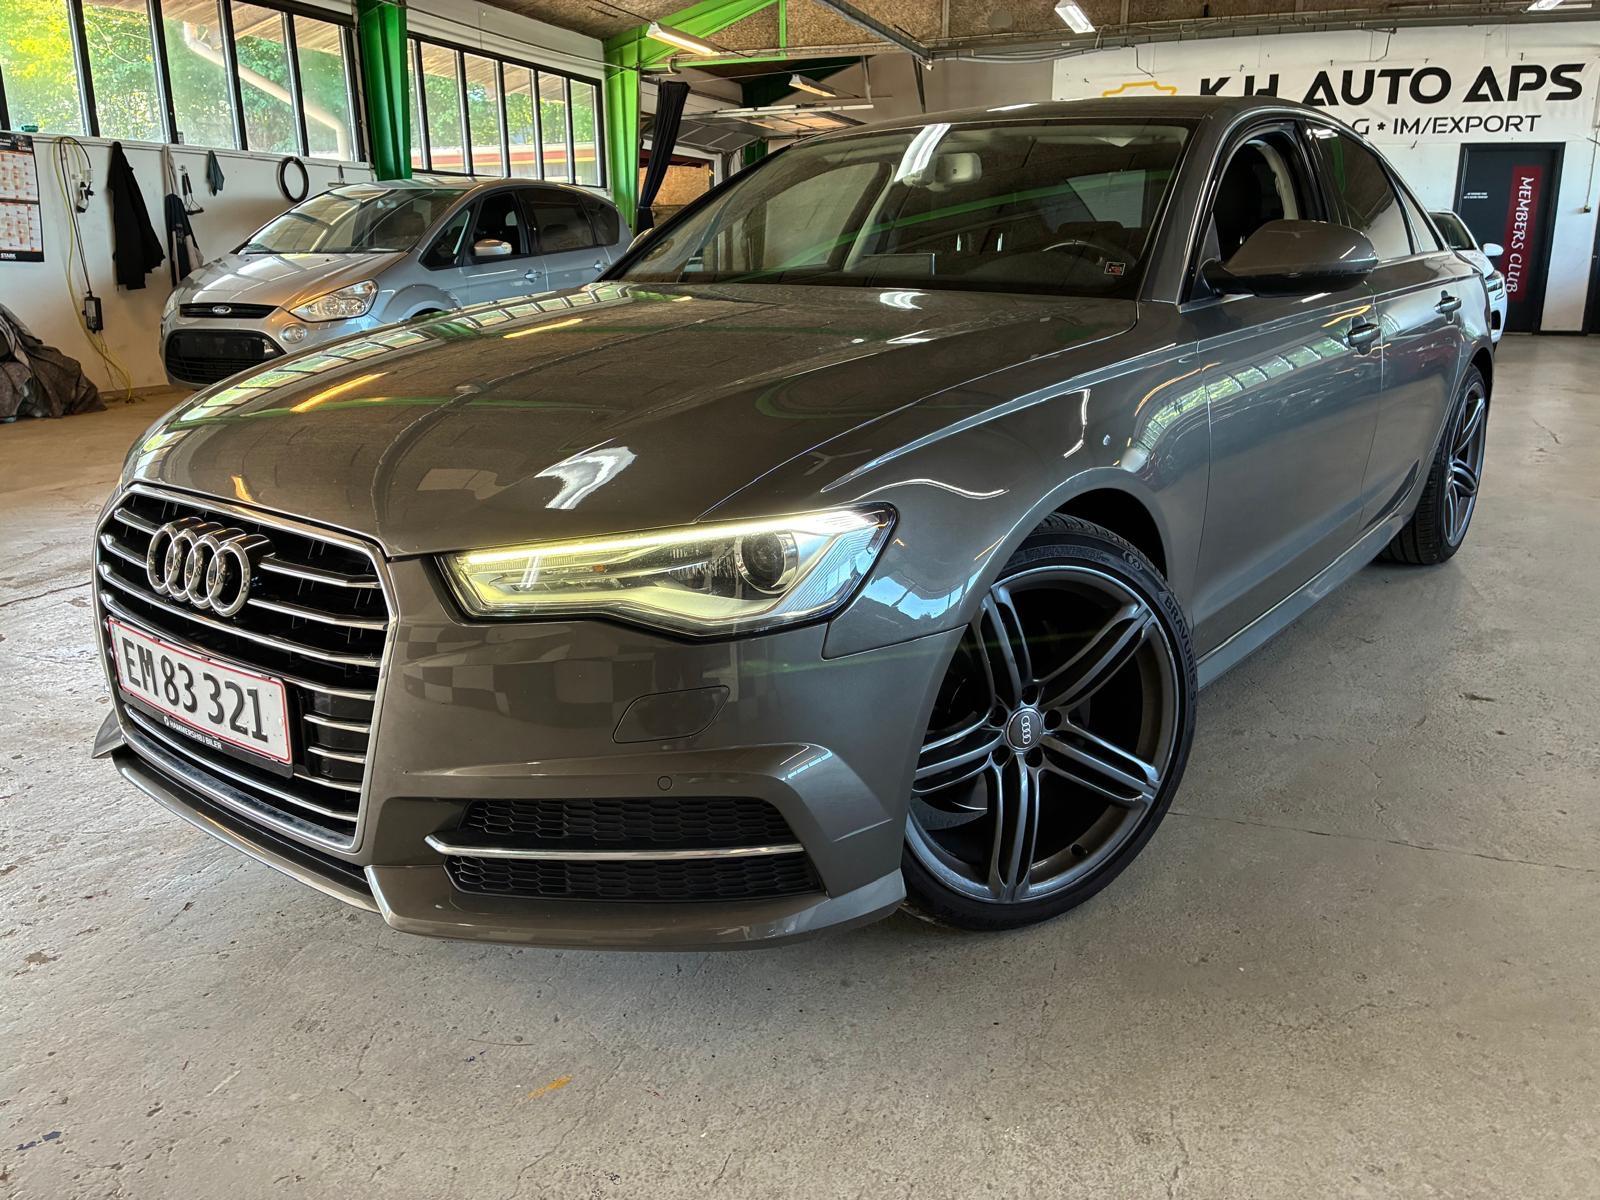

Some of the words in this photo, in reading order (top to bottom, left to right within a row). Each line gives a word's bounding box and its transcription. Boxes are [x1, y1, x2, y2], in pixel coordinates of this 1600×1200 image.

[1301, 67, 1451, 107] AUTO
[1462, 63, 1586, 103] APS
[1393, 115, 1542, 135] IM/EXPORT
[1511, 176, 1535, 251] MEMBERS
[1505, 252, 1522, 293] CLUB
[121, 636, 159, 697] EM
[160, 655, 198, 713] 83
[203, 673, 269, 743] 321
